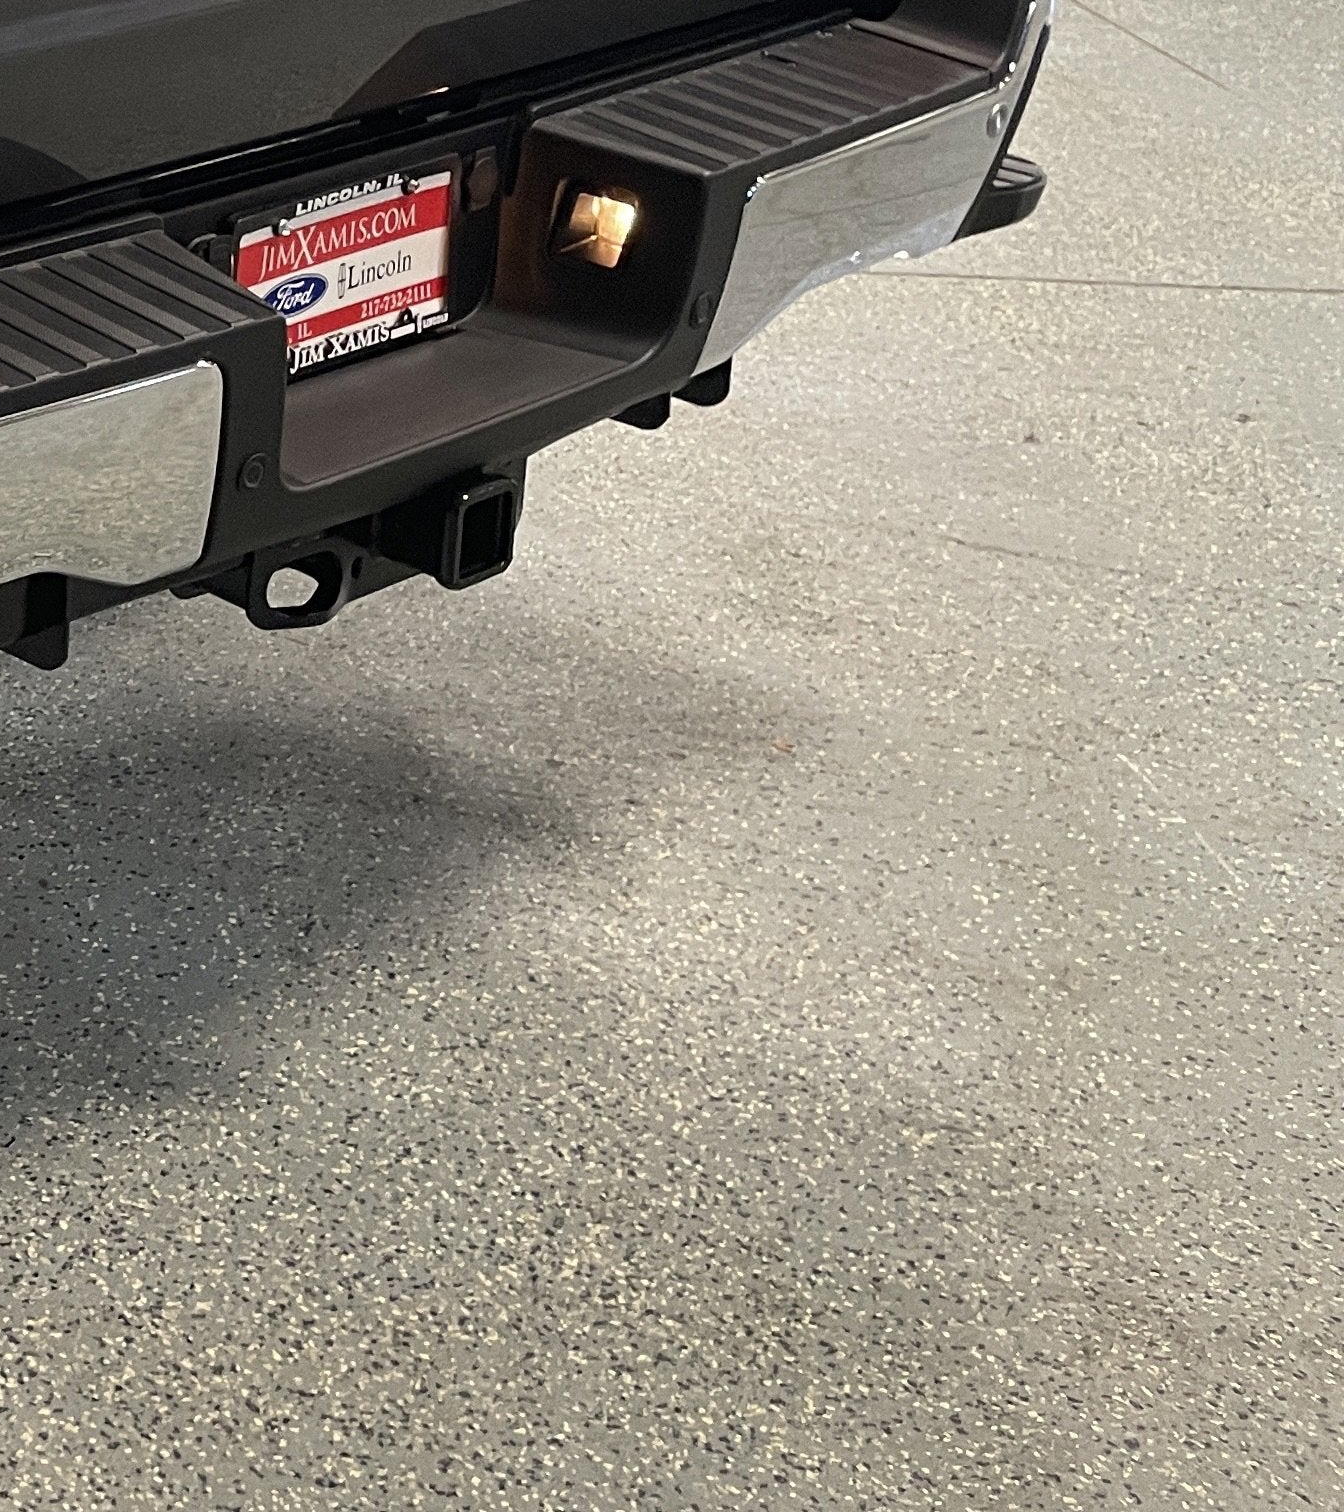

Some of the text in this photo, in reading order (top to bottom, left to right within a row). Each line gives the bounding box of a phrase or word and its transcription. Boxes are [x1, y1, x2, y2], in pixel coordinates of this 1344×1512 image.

[296, 173, 404, 217] LINCOLN, IL
[347, 249, 412, 290] Lincoln
[273, 280, 315, 311] Ford
